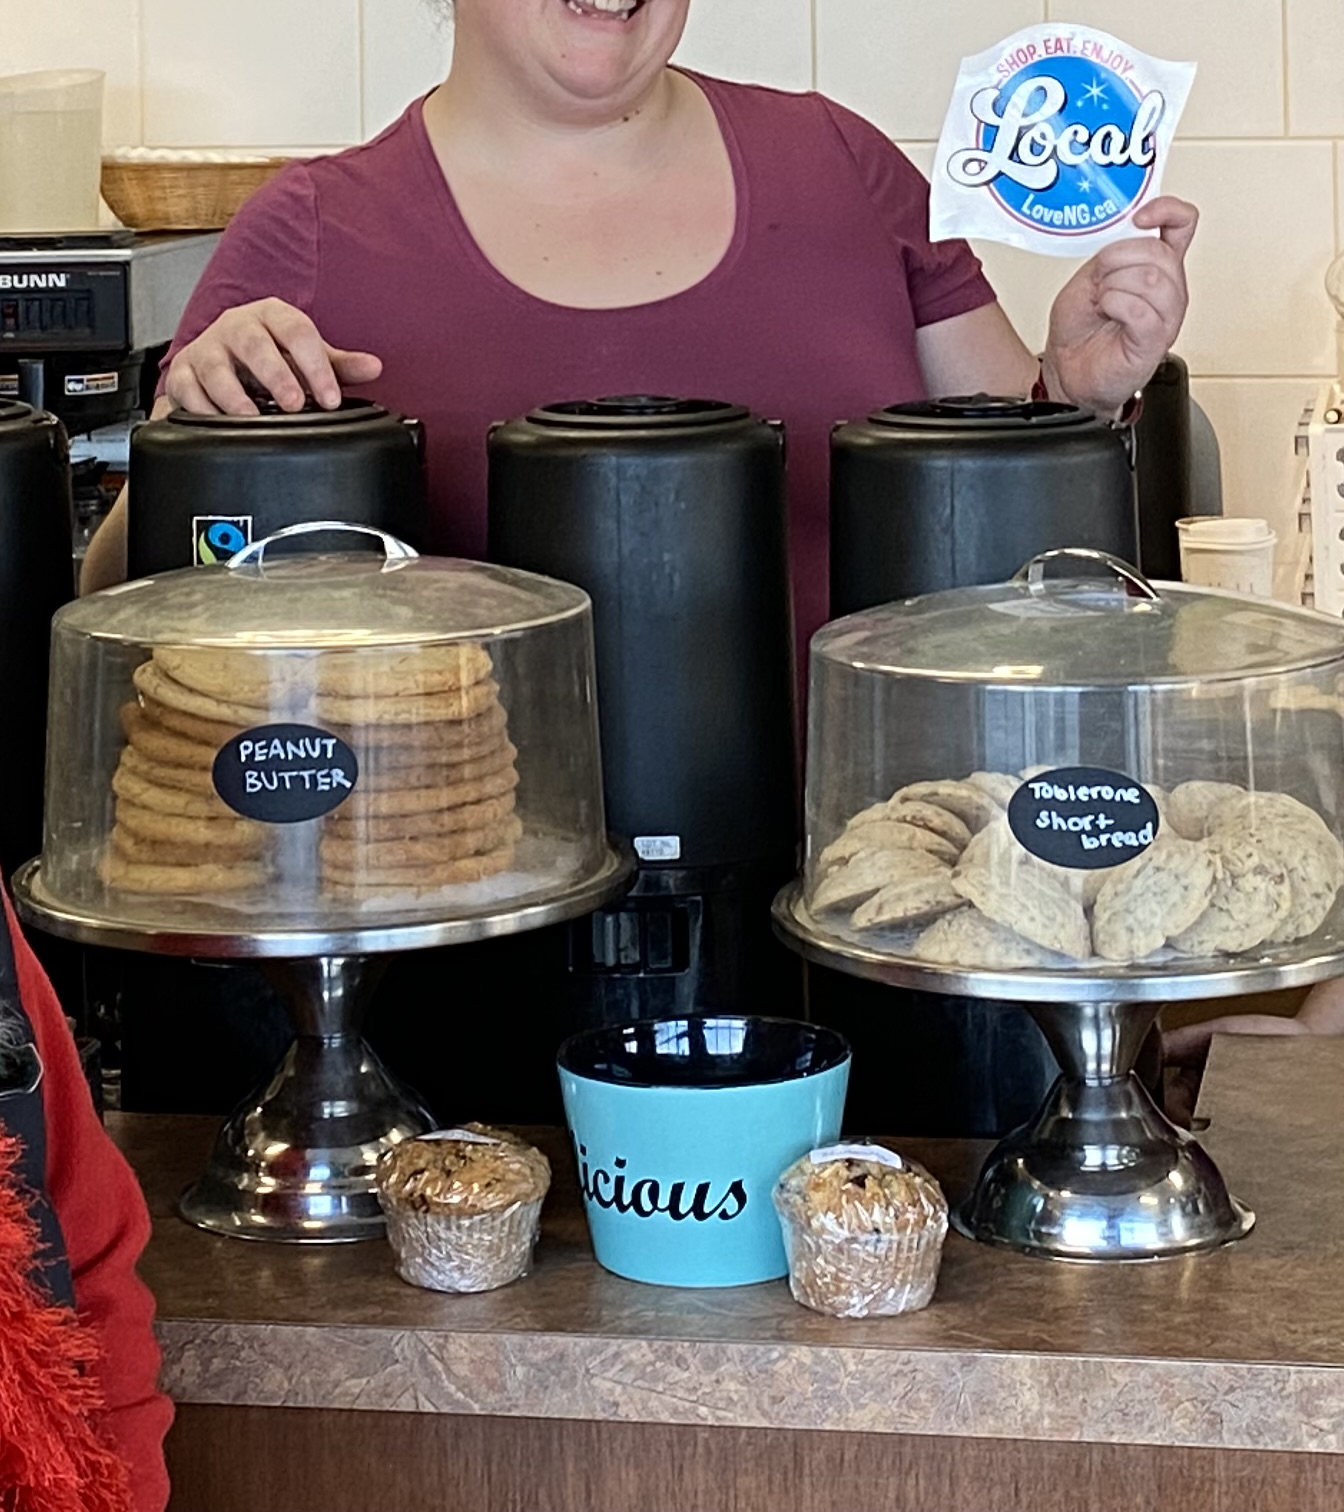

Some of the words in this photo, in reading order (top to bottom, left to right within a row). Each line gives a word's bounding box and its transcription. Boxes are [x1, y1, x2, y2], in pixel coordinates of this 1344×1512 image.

[947, 74, 1166, 192] Local
[1021, 193, 1117, 226] LoveNG.ca
[239, 738, 337, 764] PEANUT
[244, 768, 352, 793] BUTTER
[1028, 782, 1141, 804] Toblerone
[1080, 823, 1154, 850] bread
[580, 1144, 748, 1221] icious
